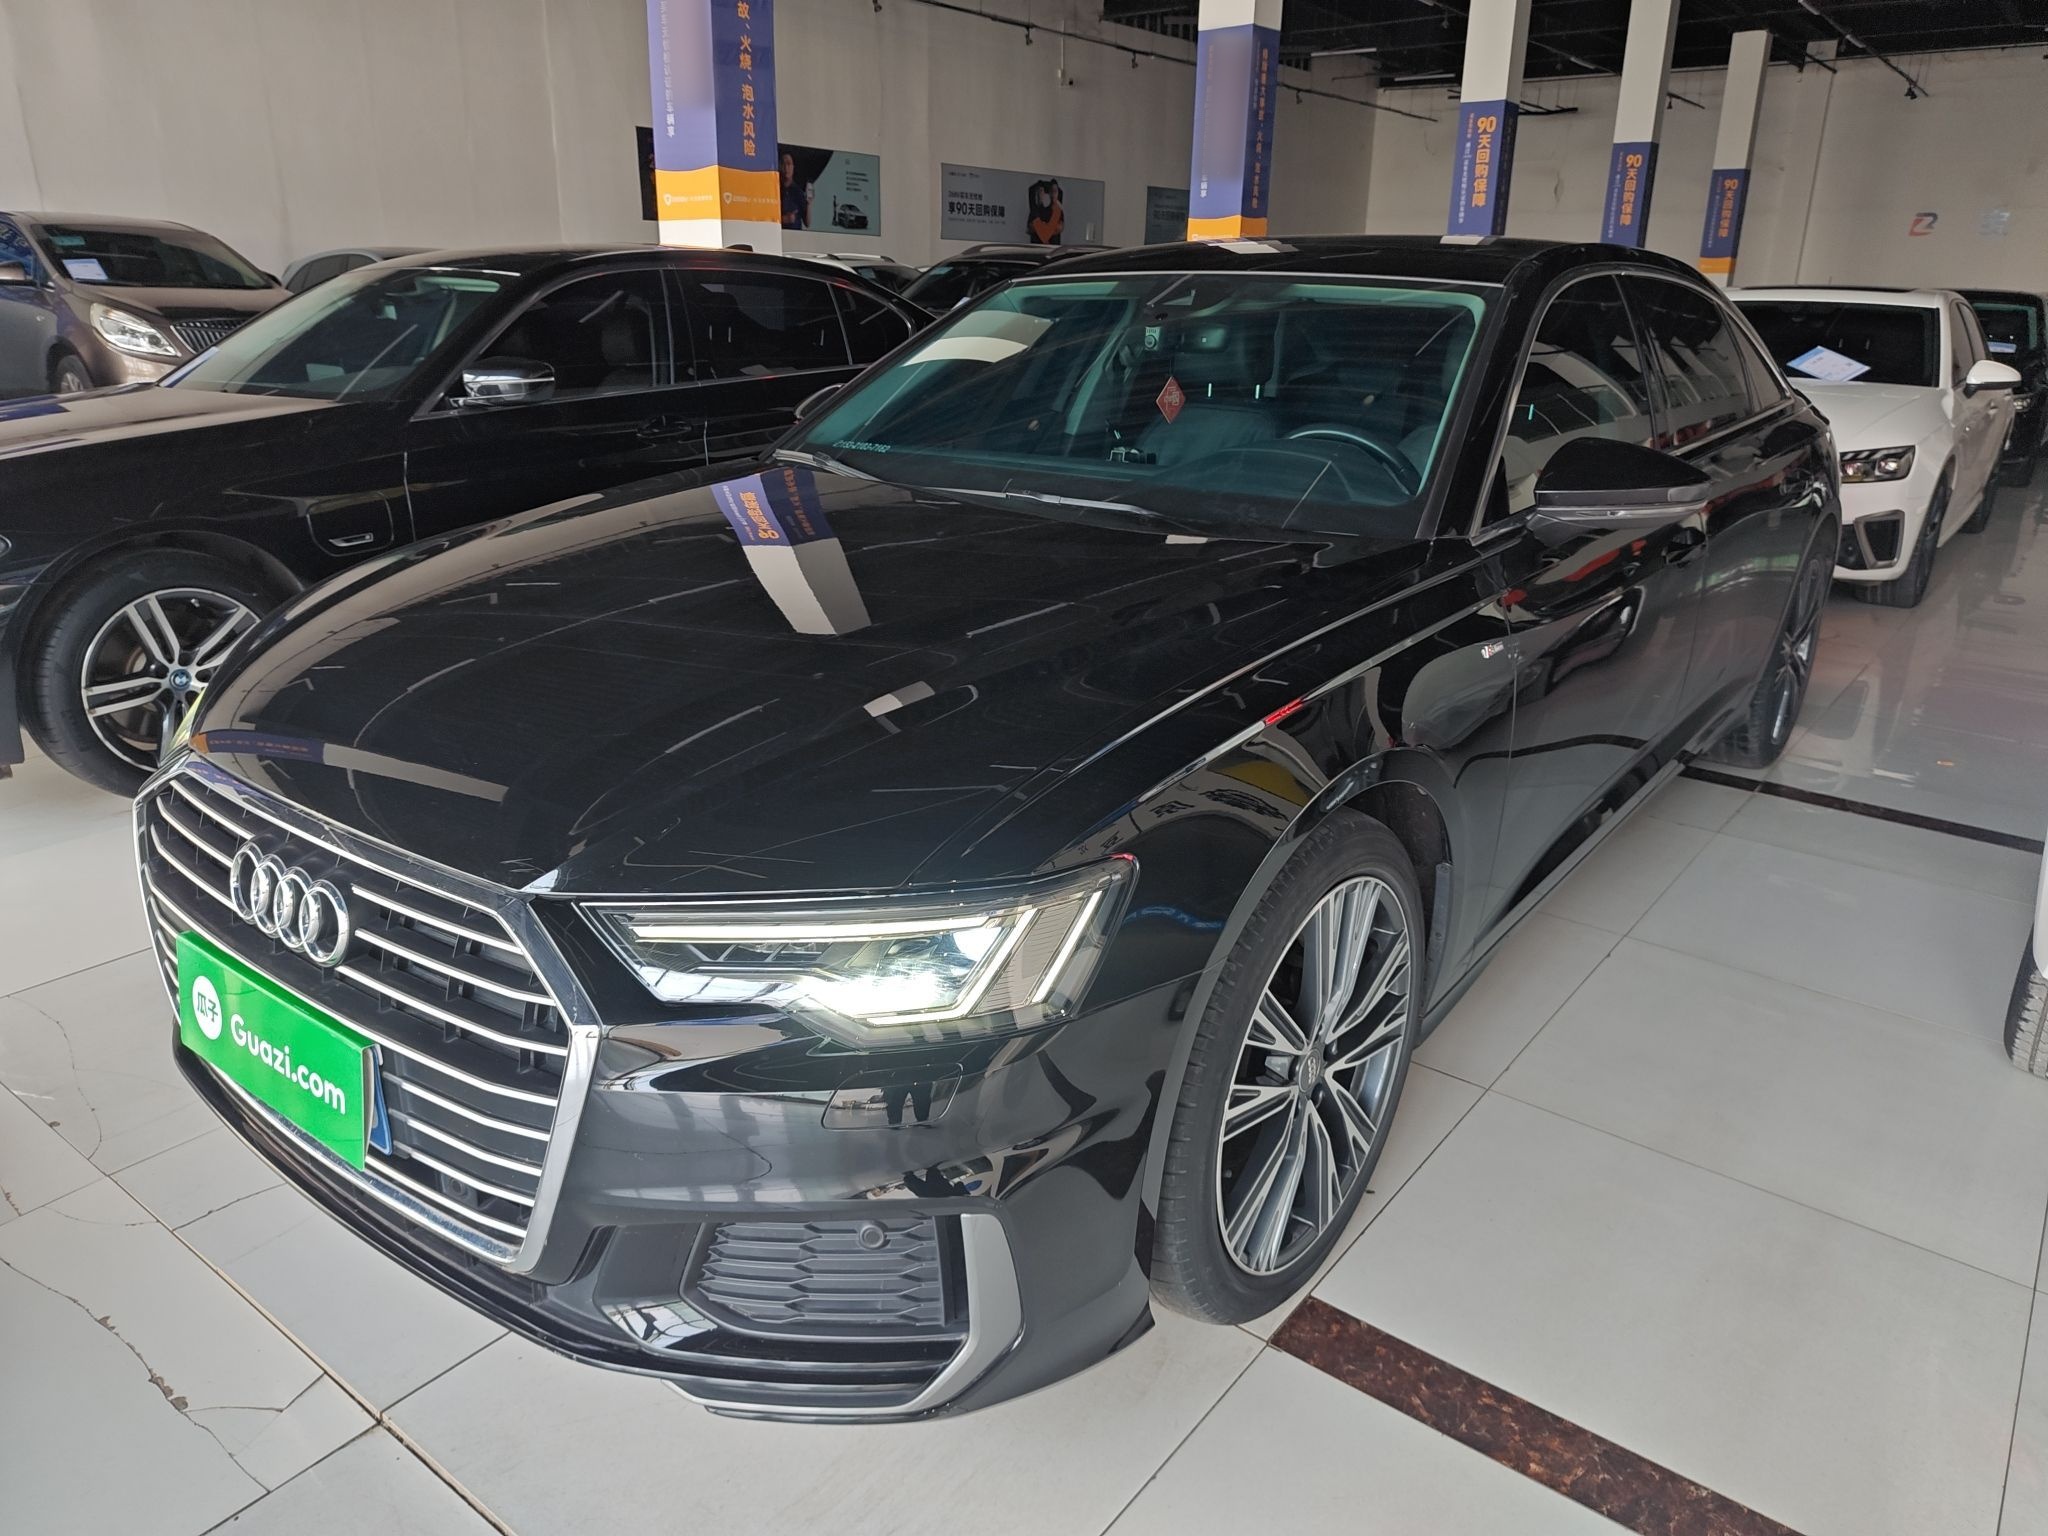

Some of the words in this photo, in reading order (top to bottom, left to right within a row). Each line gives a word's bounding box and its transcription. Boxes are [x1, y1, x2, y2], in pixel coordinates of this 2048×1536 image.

[1473, 116, 1497, 207] 90天回购保障
[197, 991, 219, 1022] 瓜子
[230, 1013, 346, 1115] Guazi.com
